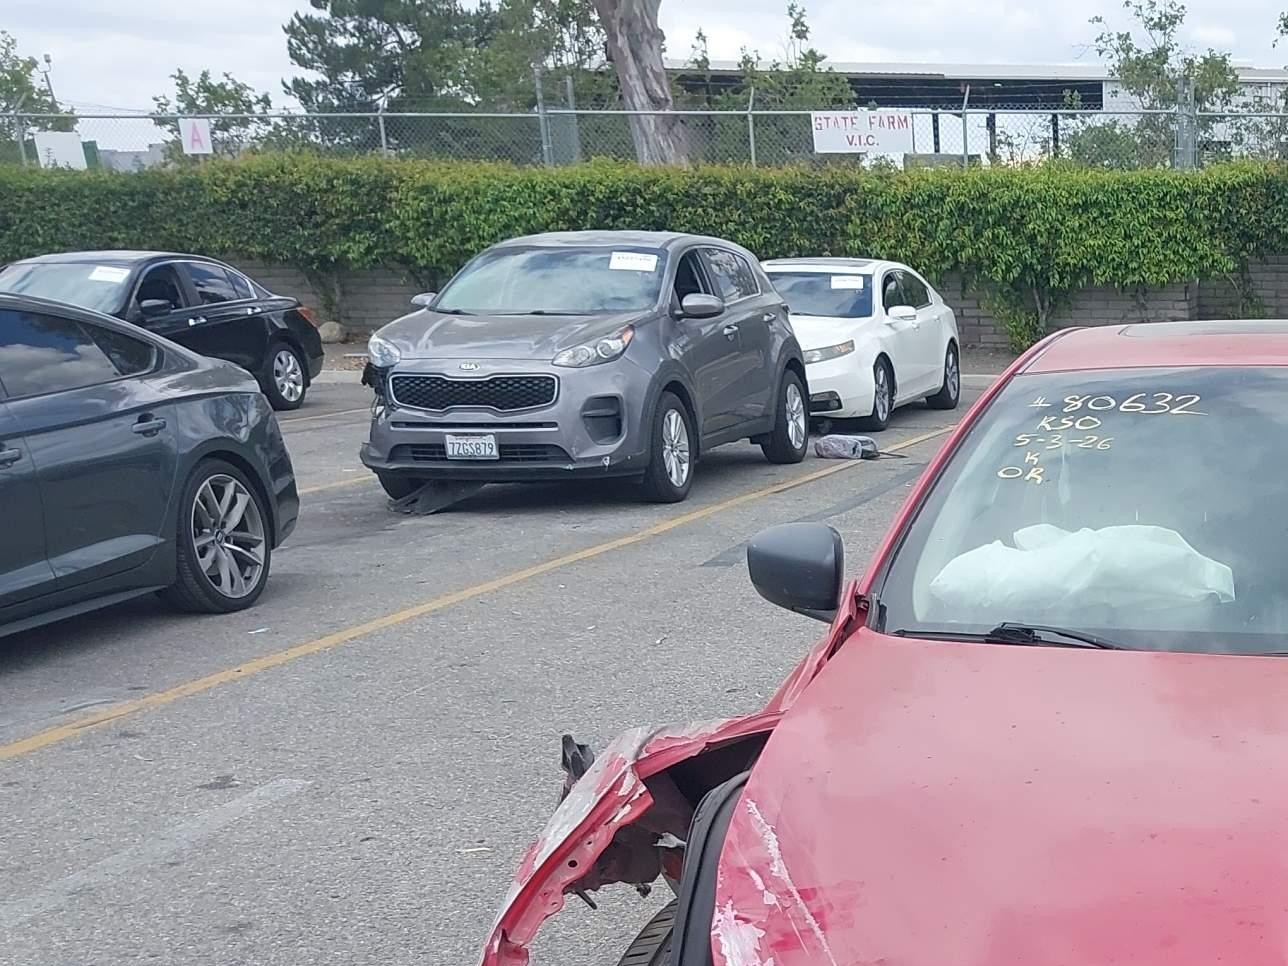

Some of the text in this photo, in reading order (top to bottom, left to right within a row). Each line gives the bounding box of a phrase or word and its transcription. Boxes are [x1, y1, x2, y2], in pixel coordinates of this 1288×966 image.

[814, 114, 910, 131] STATE FARM
[190, 121, 204, 150] A
[846, 134, 880, 147] V.I.C.
